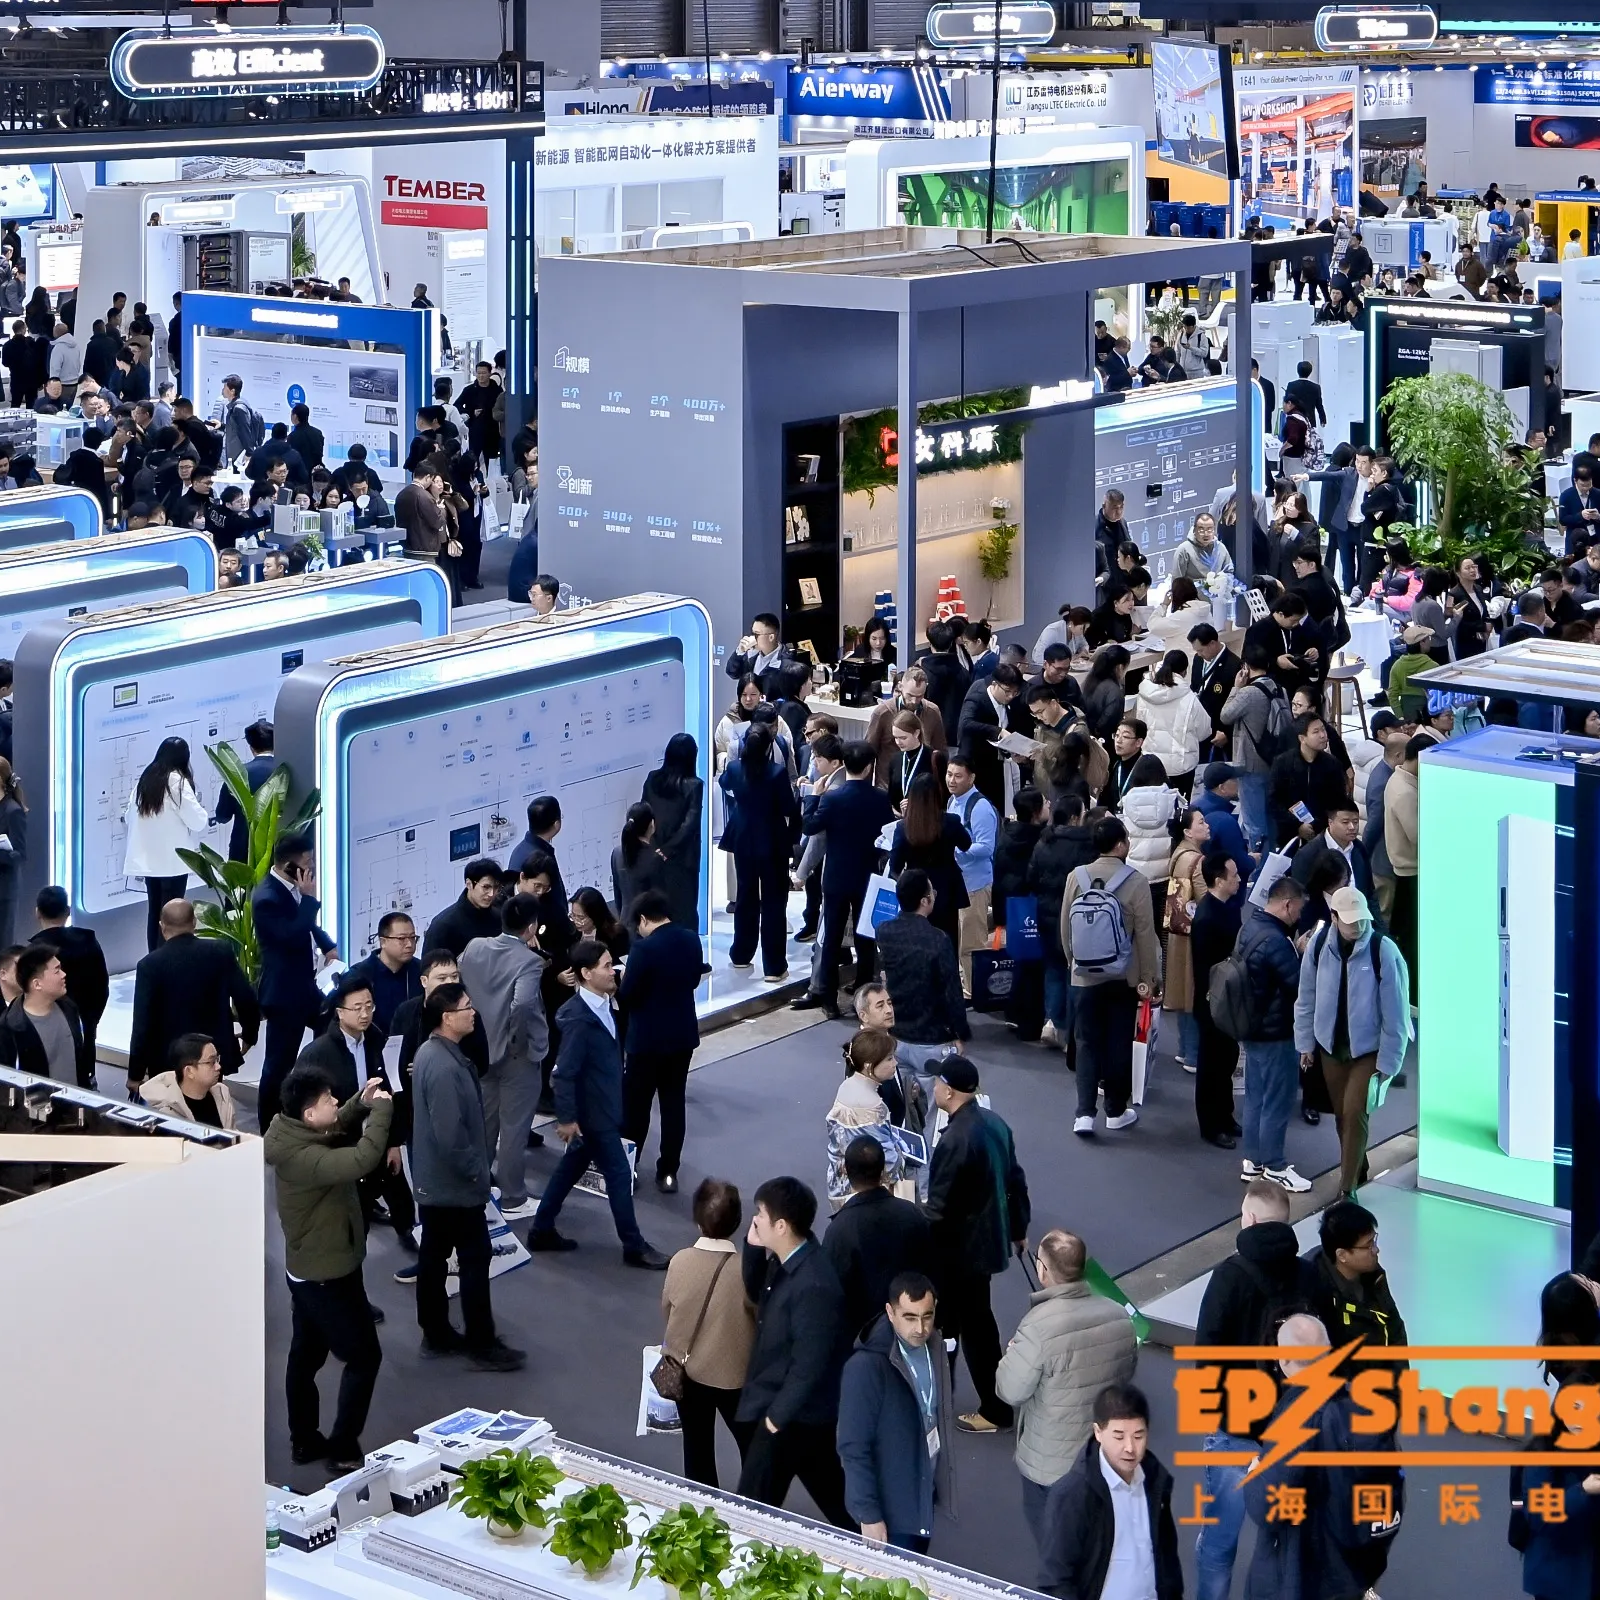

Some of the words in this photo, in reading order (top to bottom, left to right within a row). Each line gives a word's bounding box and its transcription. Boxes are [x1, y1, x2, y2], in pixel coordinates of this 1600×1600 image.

[800, 76, 895, 104] Aierway
[535, 149, 570, 167] 新能源
[574, 138, 757, 164] 智能配网自动化一体化解决方案提供者
[383, 175, 486, 202] TEMBER
[565, 356, 590, 374] 规模
[568, 477, 593, 496] 创新
[558, 505, 590, 518] 500+
[602, 510, 634, 523] 340+
[646, 515, 679, 528] 450+
[692, 520, 722, 533] 10%+
